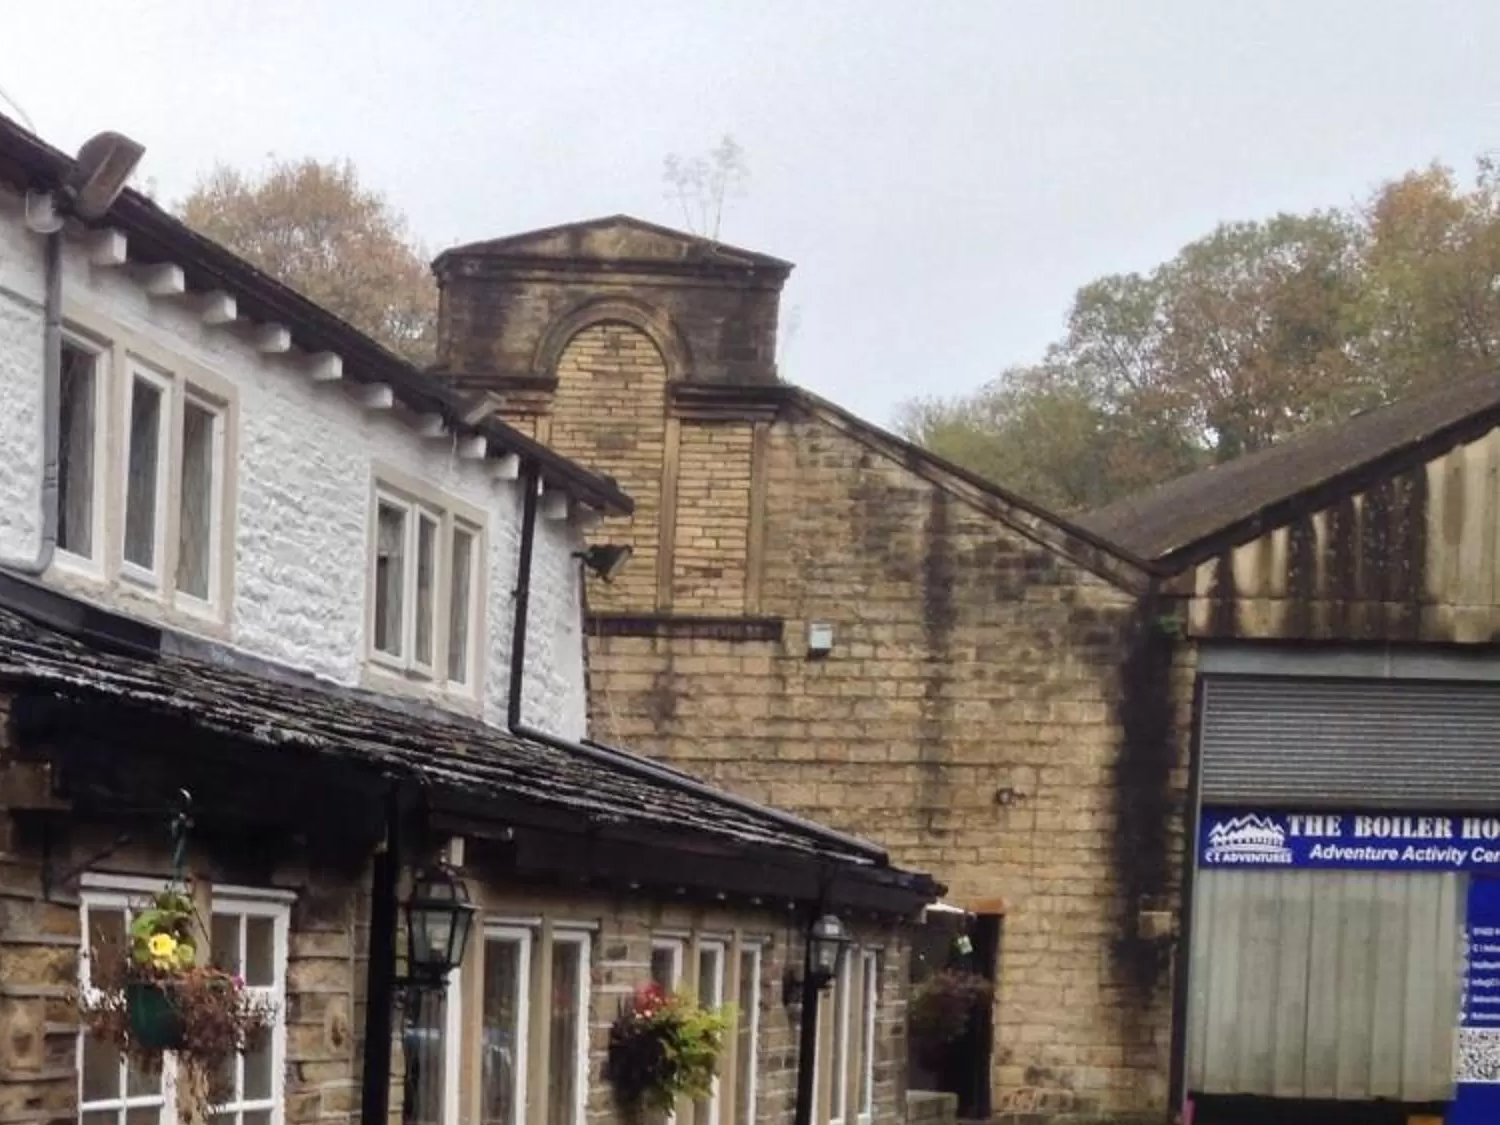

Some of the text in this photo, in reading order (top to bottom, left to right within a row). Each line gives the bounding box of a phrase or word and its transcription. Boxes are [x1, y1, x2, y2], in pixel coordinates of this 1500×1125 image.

[1286, 815, 1342, 837] THE
[1354, 815, 1453, 839] BOILER
[1309, 843, 1399, 861] Adventure
[1402, 844, 1468, 866] Activity
